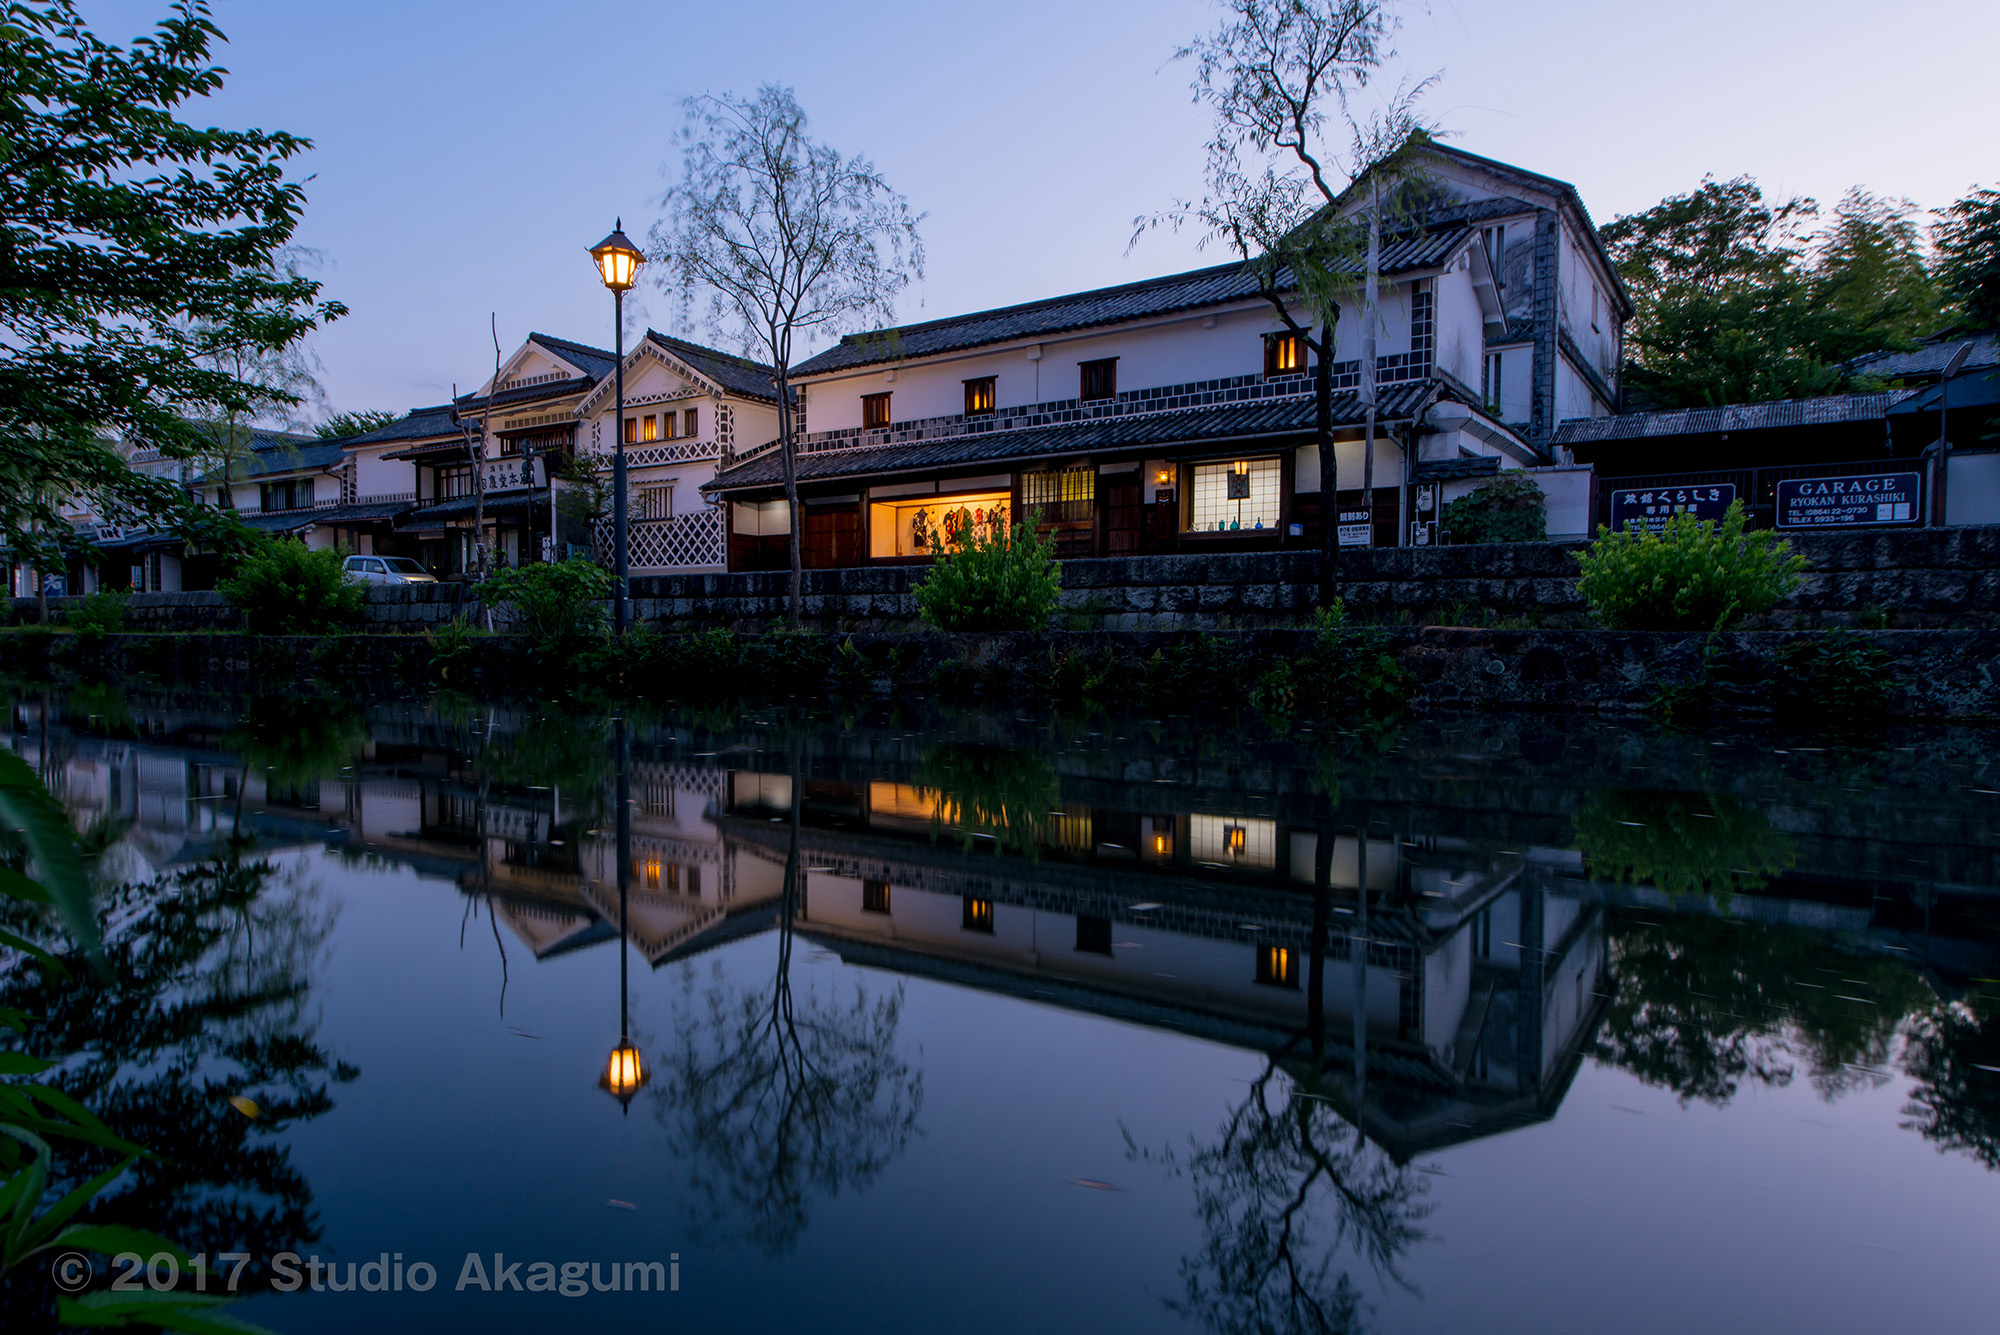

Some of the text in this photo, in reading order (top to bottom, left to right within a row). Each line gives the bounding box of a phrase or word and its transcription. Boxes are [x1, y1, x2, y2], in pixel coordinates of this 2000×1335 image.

[1799, 478, 1896, 495] GARAGE
[1790, 492, 1906, 508] RYOKAN KURASHIKI
[1339, 511, 1369, 522] 規制あり
[1787, 516, 1812, 524] TELEX
